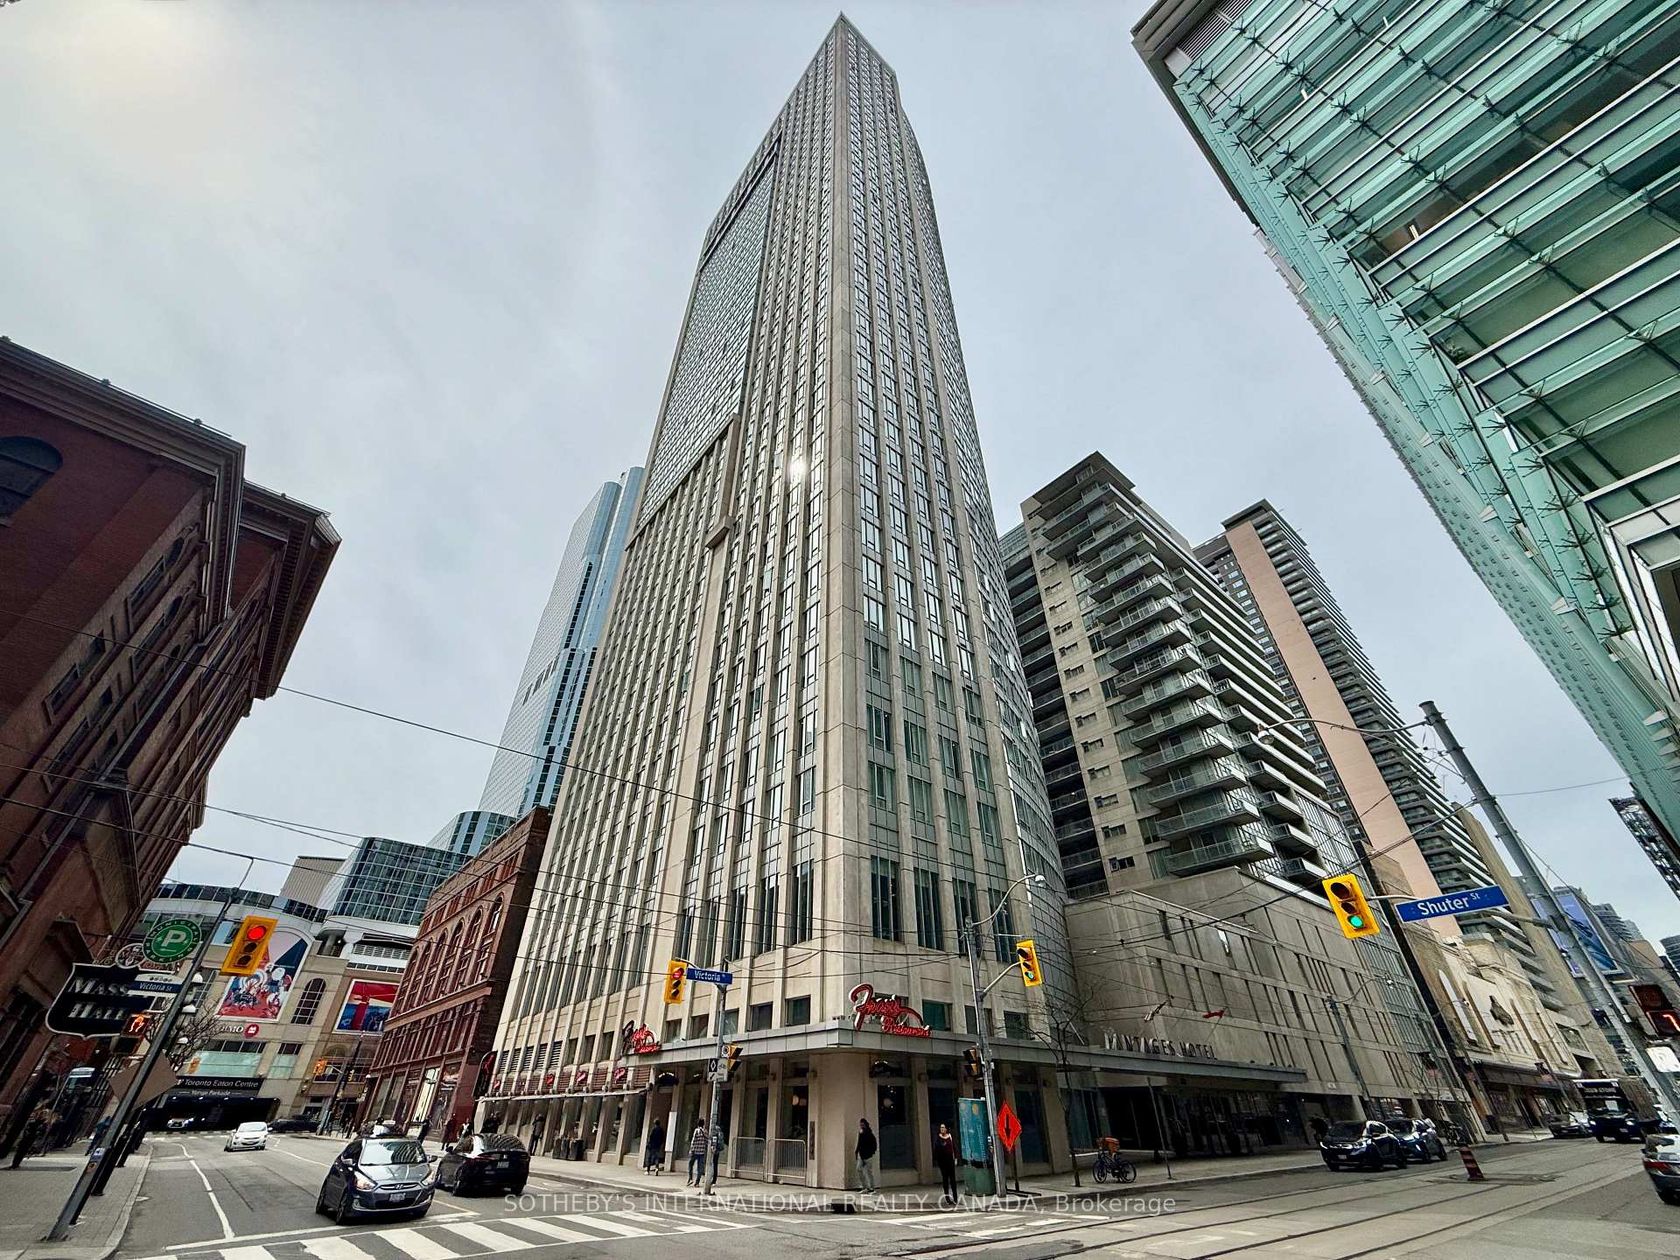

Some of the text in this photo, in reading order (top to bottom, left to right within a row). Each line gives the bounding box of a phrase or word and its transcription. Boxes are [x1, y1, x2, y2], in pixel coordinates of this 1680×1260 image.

[1417, 892, 1481, 915] Shuter St
[161, 929, 187, 947] P
[694, 970, 721, 981] Victoria
[140, 982, 166, 991] Victoria
[185, 1079, 212, 1087] Toronto
[213, 1079, 233, 1087] Eaton
[234, 1080, 259, 1088] Centre
